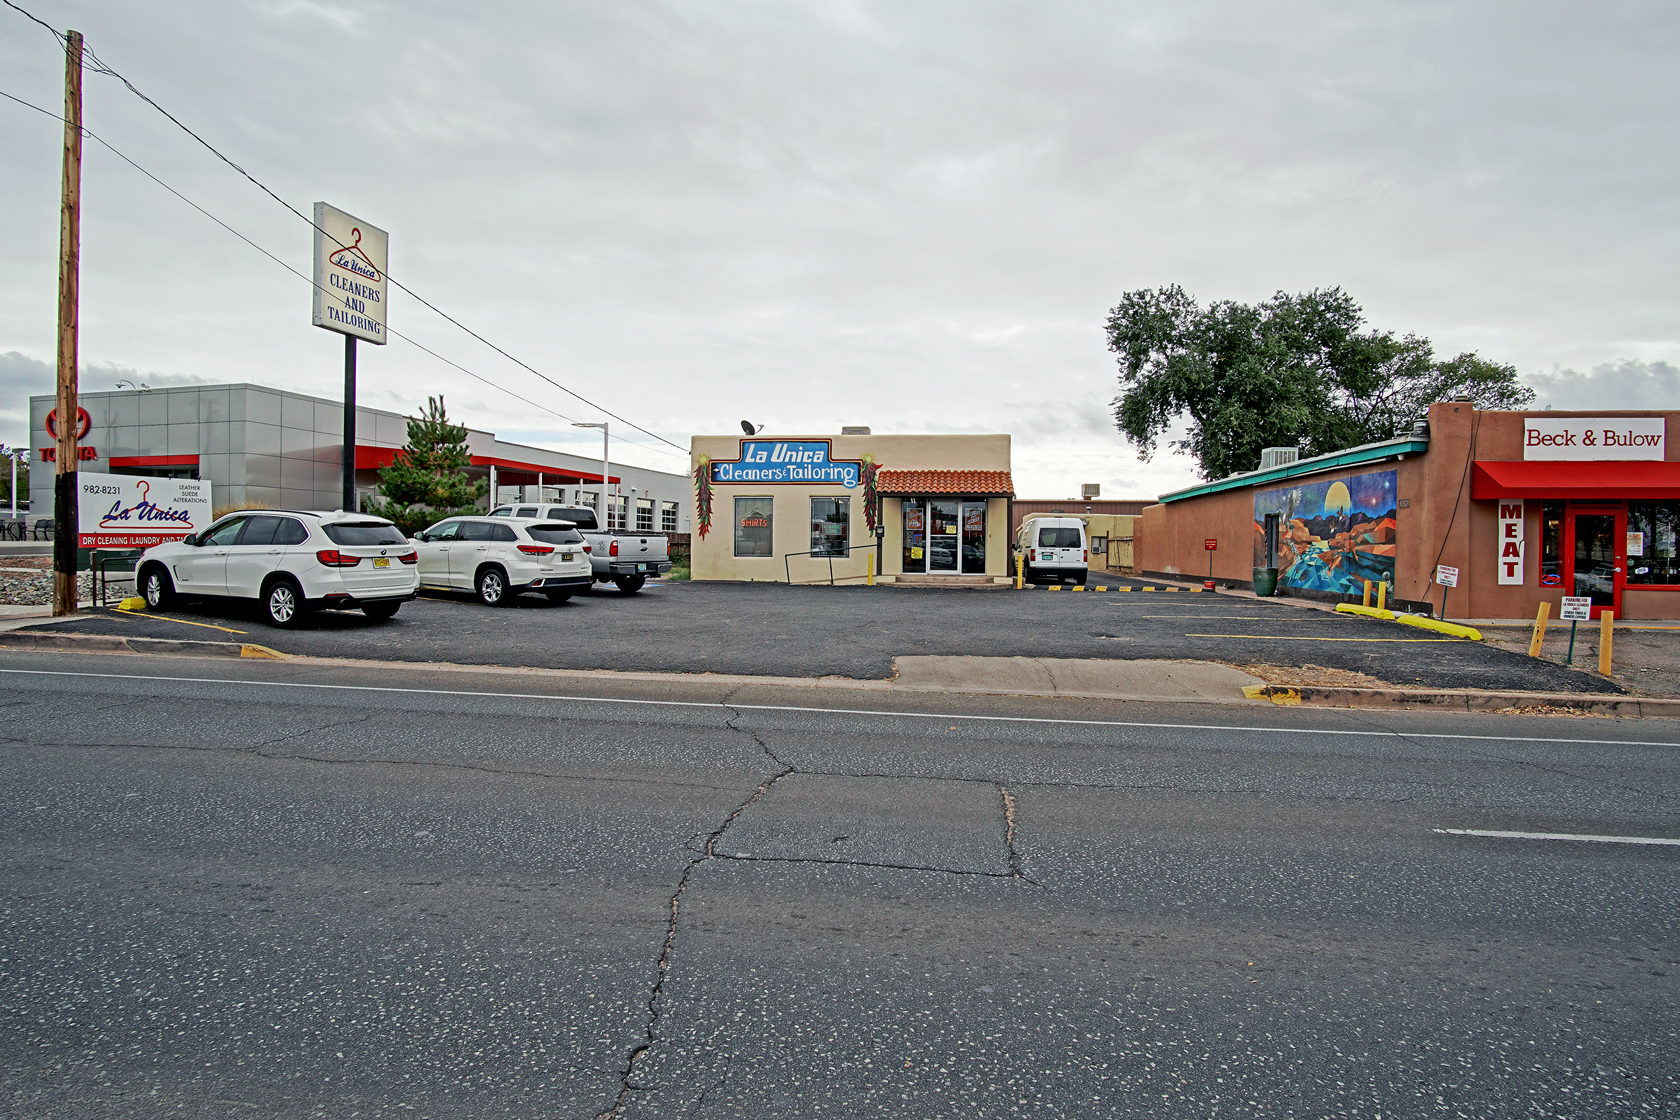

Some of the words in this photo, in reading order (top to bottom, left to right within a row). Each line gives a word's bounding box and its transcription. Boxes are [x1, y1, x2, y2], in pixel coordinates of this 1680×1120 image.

[335, 254, 349, 267] La
[351, 259, 375, 278] Unica
[329, 272, 381, 303] CLEANERS
[344, 296, 366, 315] AND
[327, 305, 381, 335] TAILORING
[1526, 429, 1577, 447] Beck
[1582, 429, 1598, 447] &
[1602, 429, 1662, 447] Bulow
[39, 446, 98, 463] TOTA
[745, 443, 768, 463] La
[770, 442, 825, 463] Unica
[720, 464, 783, 480] Cleaners
[786, 463, 856, 487] Tailoring
[83, 485, 121, 495] 982-8231
[102, 500, 131, 521] La
[135, 501, 190, 522] Unica
[741, 518, 767, 528] SHIRTS
[82, 537, 96, 545] DRY
[97, 537, 128, 545] CLEANING
[129, 537, 160, 545] /LAUNDRY
[1500, 504, 1522, 578] MEAT
